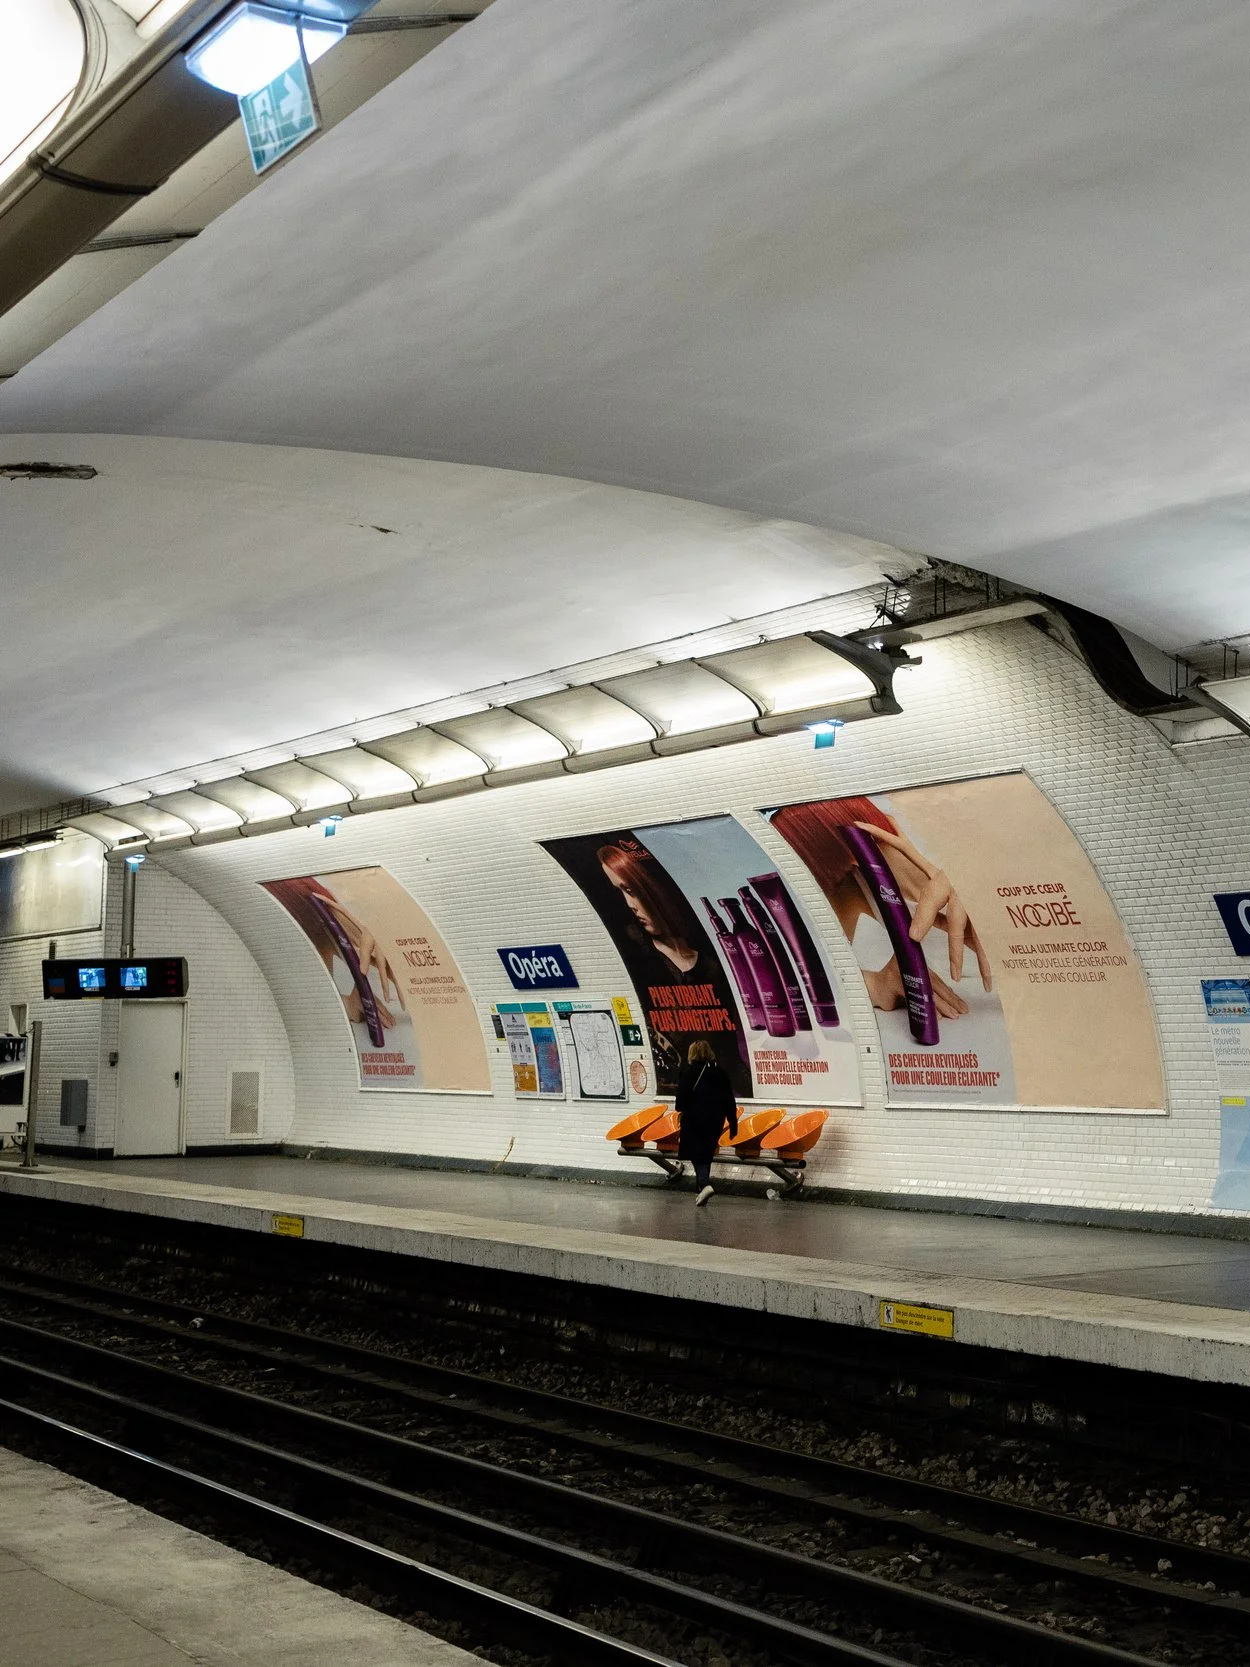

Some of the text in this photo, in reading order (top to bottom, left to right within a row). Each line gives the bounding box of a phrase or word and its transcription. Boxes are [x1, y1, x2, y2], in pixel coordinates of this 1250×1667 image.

[997, 883, 1065, 897] COUP DE CŒUR
[1006, 895, 1081, 928] NOCIBÉ
[1009, 941, 1108, 954] WELLA ULTIMATE COLOR
[508, 951, 563, 984] Opéra
[1002, 955, 1127, 969] NOTRE NOUVELLE GÉNÉRATION
[1029, 972, 1107, 983] DE SOINS COULEUR
[648, 984, 720, 1008] PLUS VIBRANT.
[649, 1008, 736, 1031] PLUS LONGTEMPS.
[1211, 1026, 1240, 1035] Le métro
[1213, 1037, 1240, 1045] nouvelle
[754, 1051, 787, 1060] ULTIMATE COLOR
[889, 1050, 979, 1068] DES CHEVEUX REVITALISÉS
[1215, 1047, 1250, 1057] génération
[755, 1058, 829, 1073] NOTRE NOUVELLE GÉNÉRATION
[757, 1074, 803, 1085] DE SOINS COULEUR
[891, 1071, 910, 1085] POUR
[911, 1071, 925, 1085] UNE
[926, 1071, 957, 1086] COULEUR
